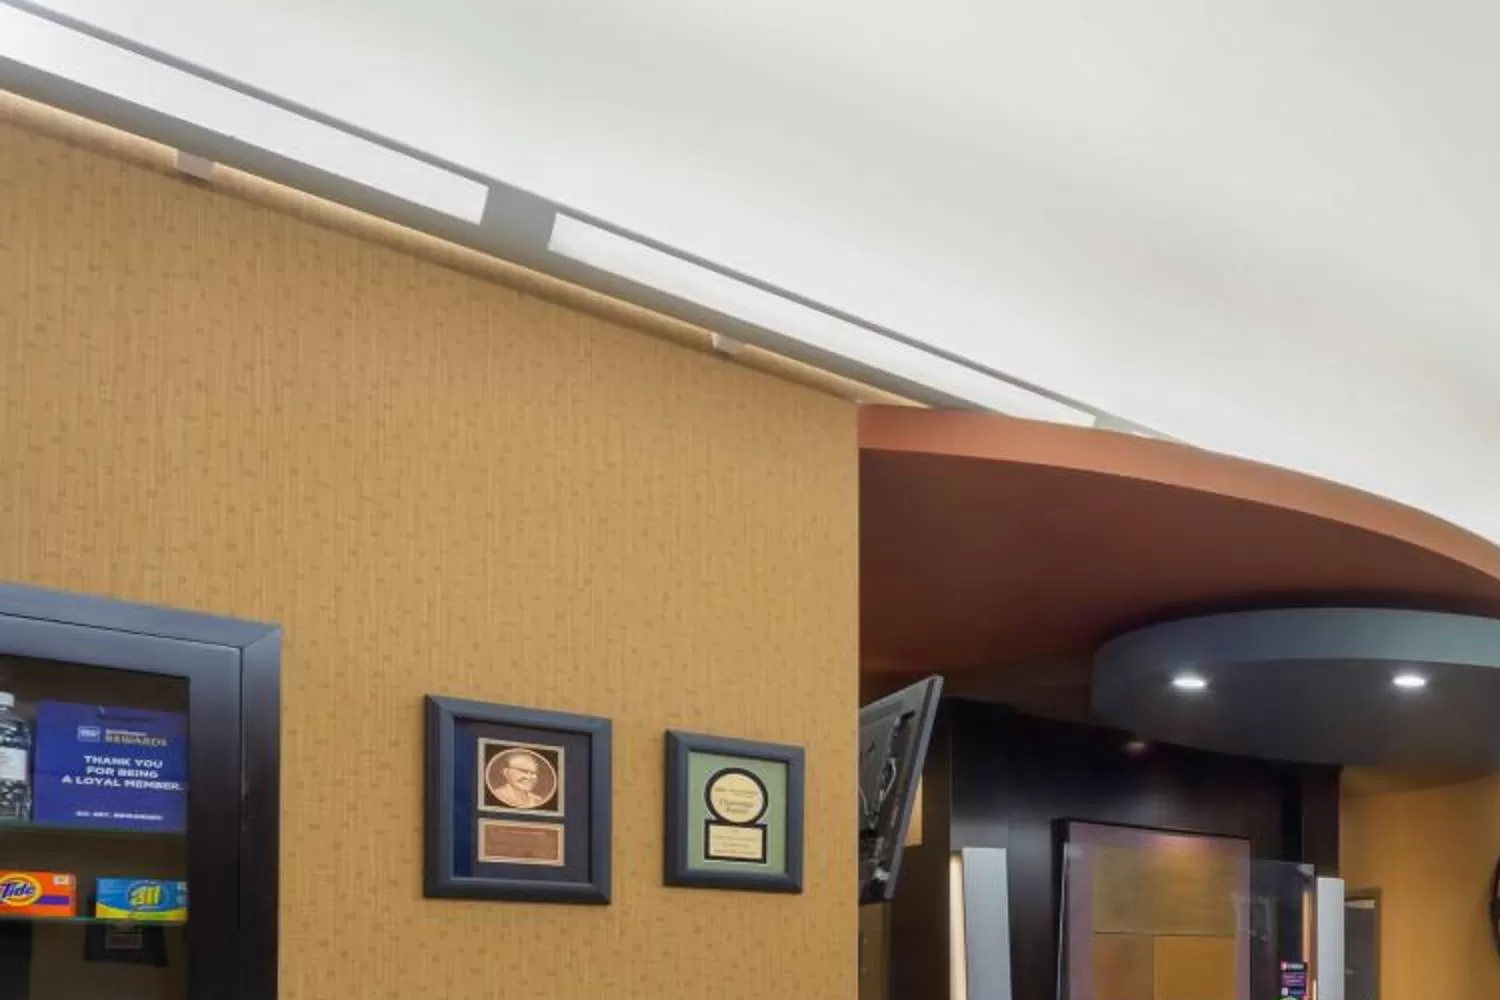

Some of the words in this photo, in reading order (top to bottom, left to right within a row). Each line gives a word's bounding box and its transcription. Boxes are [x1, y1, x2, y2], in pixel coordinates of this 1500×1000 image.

[84, 755, 131, 766] THANK
[134, 758, 163, 769] YOU
[86, 766, 114, 776] FOR
[118, 768, 158, 779] BEING
[62, 774, 73, 784] A
[75, 776, 121, 787] LOYAL
[130, 885, 161, 906] all
